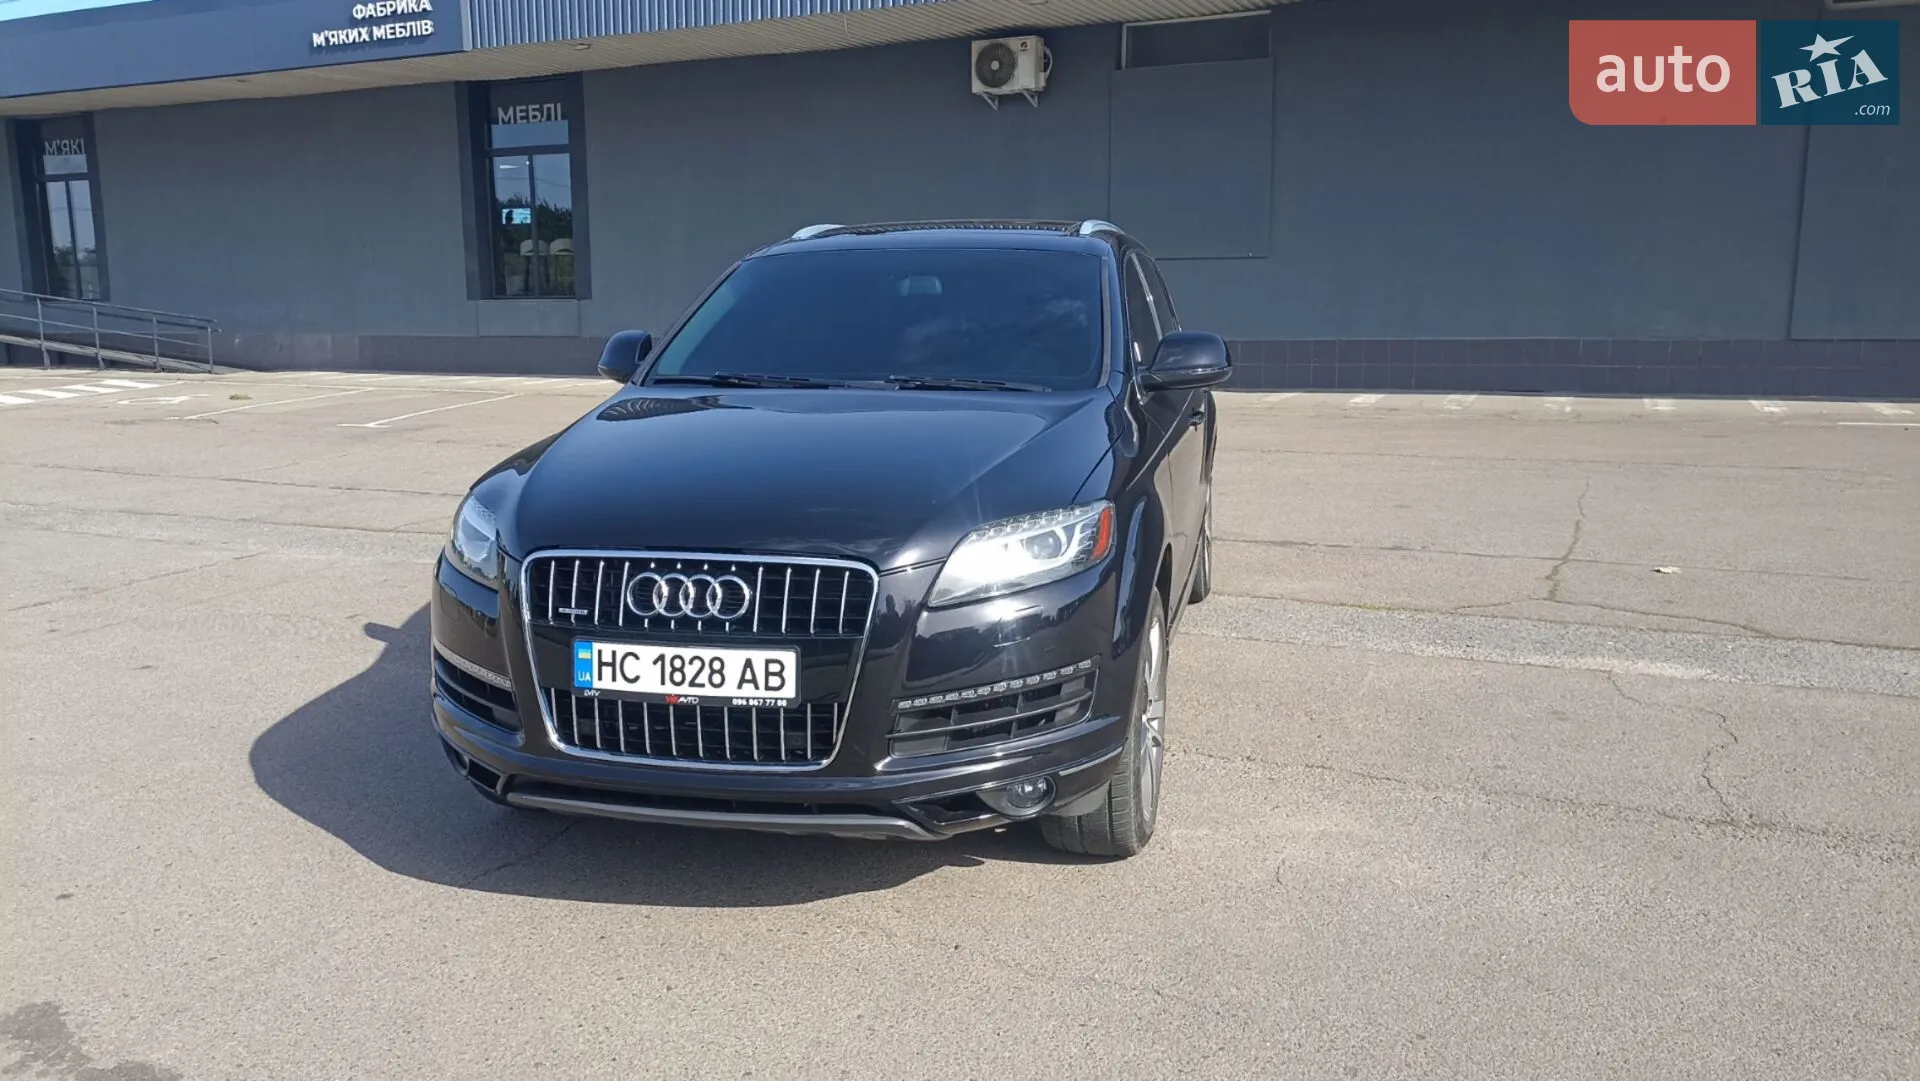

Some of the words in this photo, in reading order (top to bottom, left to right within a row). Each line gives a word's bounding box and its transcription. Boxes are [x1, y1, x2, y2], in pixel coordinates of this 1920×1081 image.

[352, 0, 433, 20] ФАБРИКА
[312, 26, 370, 48] М'ЯКИХ
[372, 19, 434, 41] МЕБЛІВ
[497, 102, 562, 125] МЕБЛІ
[44, 137, 85, 156] М'ЯКІ
[578, 671, 591, 682] UA
[597, 648, 641, 684] HC
[652, 653, 726, 689] 1828
[736, 657, 786, 692] AB
